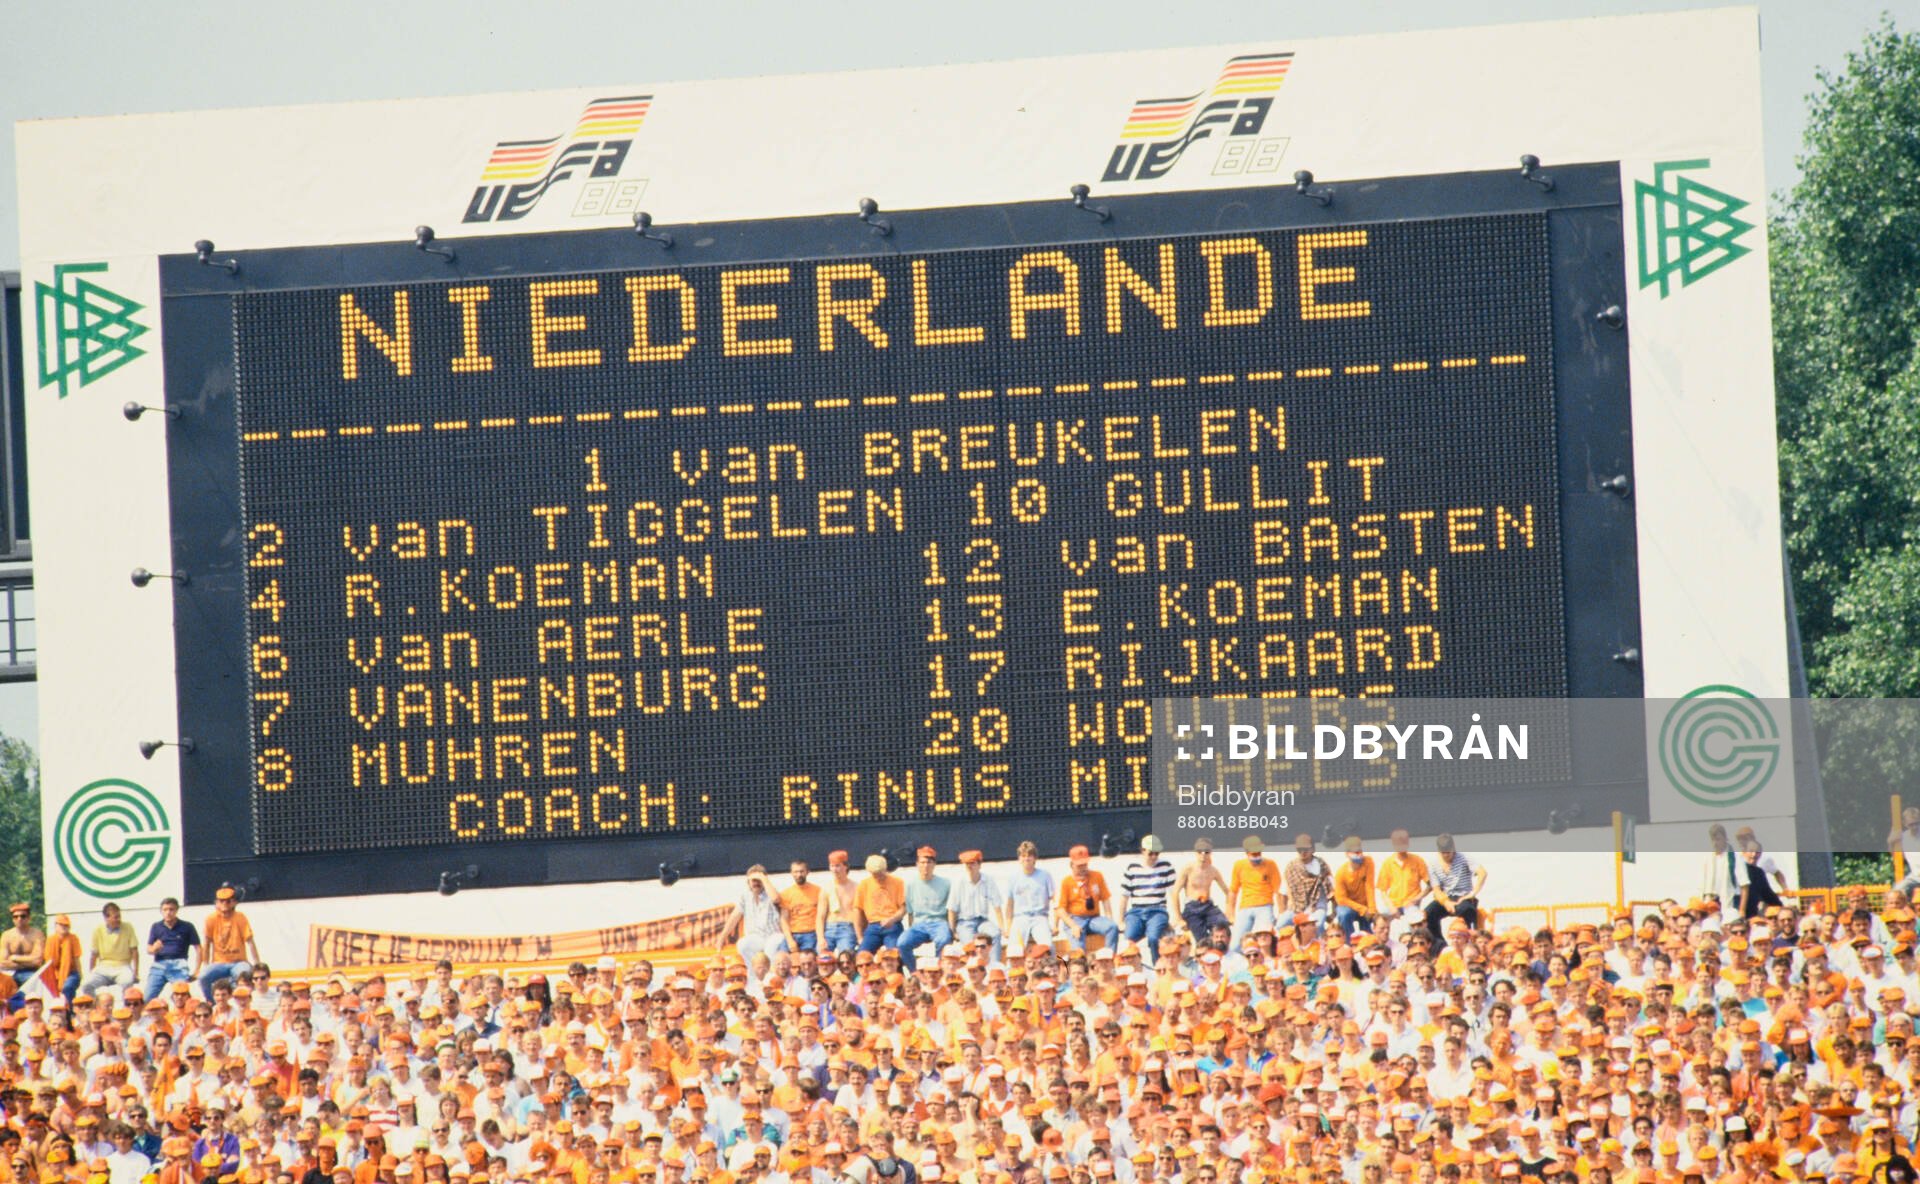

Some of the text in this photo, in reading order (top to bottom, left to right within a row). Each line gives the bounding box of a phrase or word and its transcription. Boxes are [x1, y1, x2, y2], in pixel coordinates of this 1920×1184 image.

[339, 230, 1371, 380] NIEDERLANDE
[584, 406, 1286, 492] 1 van BREUKELEN
[248, 487, 904, 567] 2 van TIGGELEN
[969, 457, 1384, 526] 10 GULLIT
[923, 504, 1534, 586] 12 van BASTEN
[251, 554, 713, 622] 4 R.KOEMAN
[925, 567, 1439, 642] 13 E.KOEMAN
[252, 608, 764, 680] 6 van AERLE
[928, 624, 1441, 699] 17 RIJKAARD
[255, 664, 766, 736] 7 VANENBURG
[924, 683, 1397, 756] 20 WOUTERS
[257, 728, 626, 791] 8 MUHREN
[449, 740, 1399, 838] COACH: RINUS MICHELS
